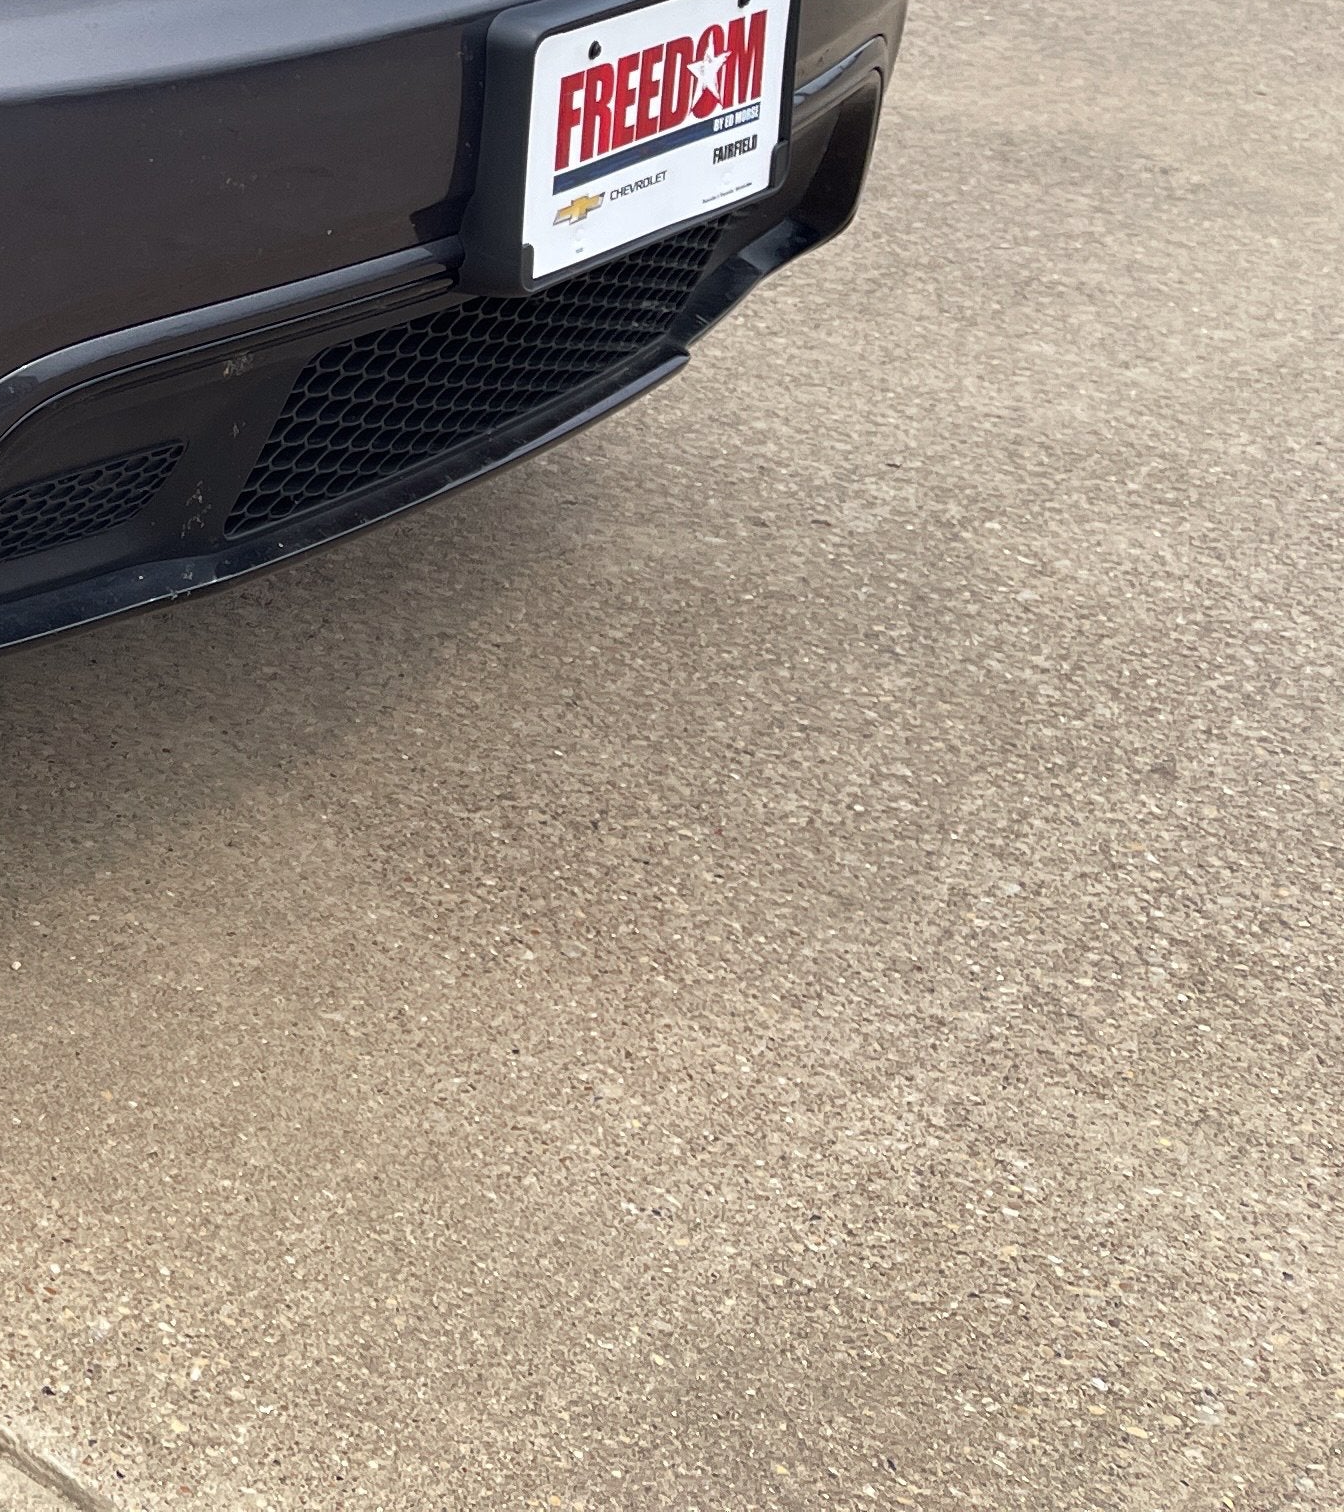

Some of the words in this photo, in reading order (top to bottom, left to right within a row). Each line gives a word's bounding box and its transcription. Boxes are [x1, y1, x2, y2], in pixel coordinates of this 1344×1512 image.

[554, 9, 768, 173] FREEDOM
[713, 117, 724, 133] BY
[724, 113, 735, 130] ED
[735, 104, 760, 126] MORSE
[713, 134, 758, 165] FAIRFIELD
[610, 170, 668, 201] CHEVROLET
